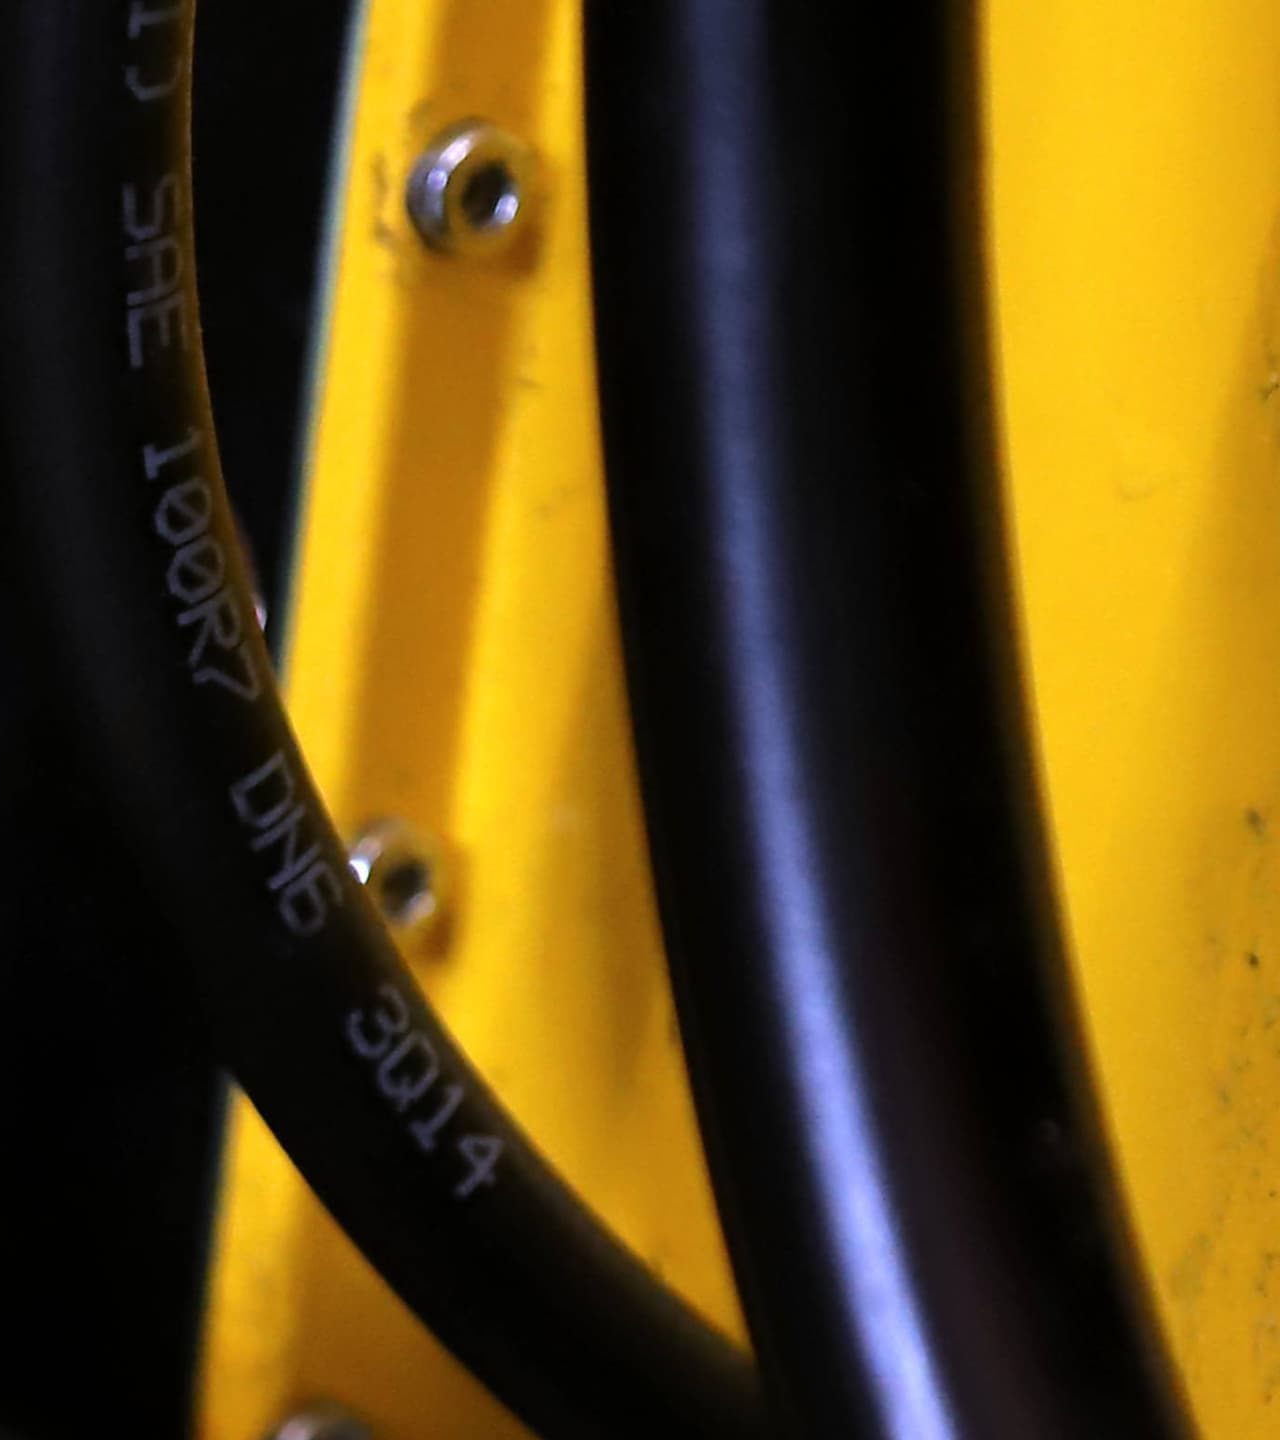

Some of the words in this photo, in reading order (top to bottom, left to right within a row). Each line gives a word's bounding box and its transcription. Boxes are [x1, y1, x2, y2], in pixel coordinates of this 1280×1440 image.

[123, 176, 186, 371] SAE
[142, 425, 264, 703] 100R7
[229, 751, 343, 936] DN6
[345, 984, 506, 1197] 3Q14
